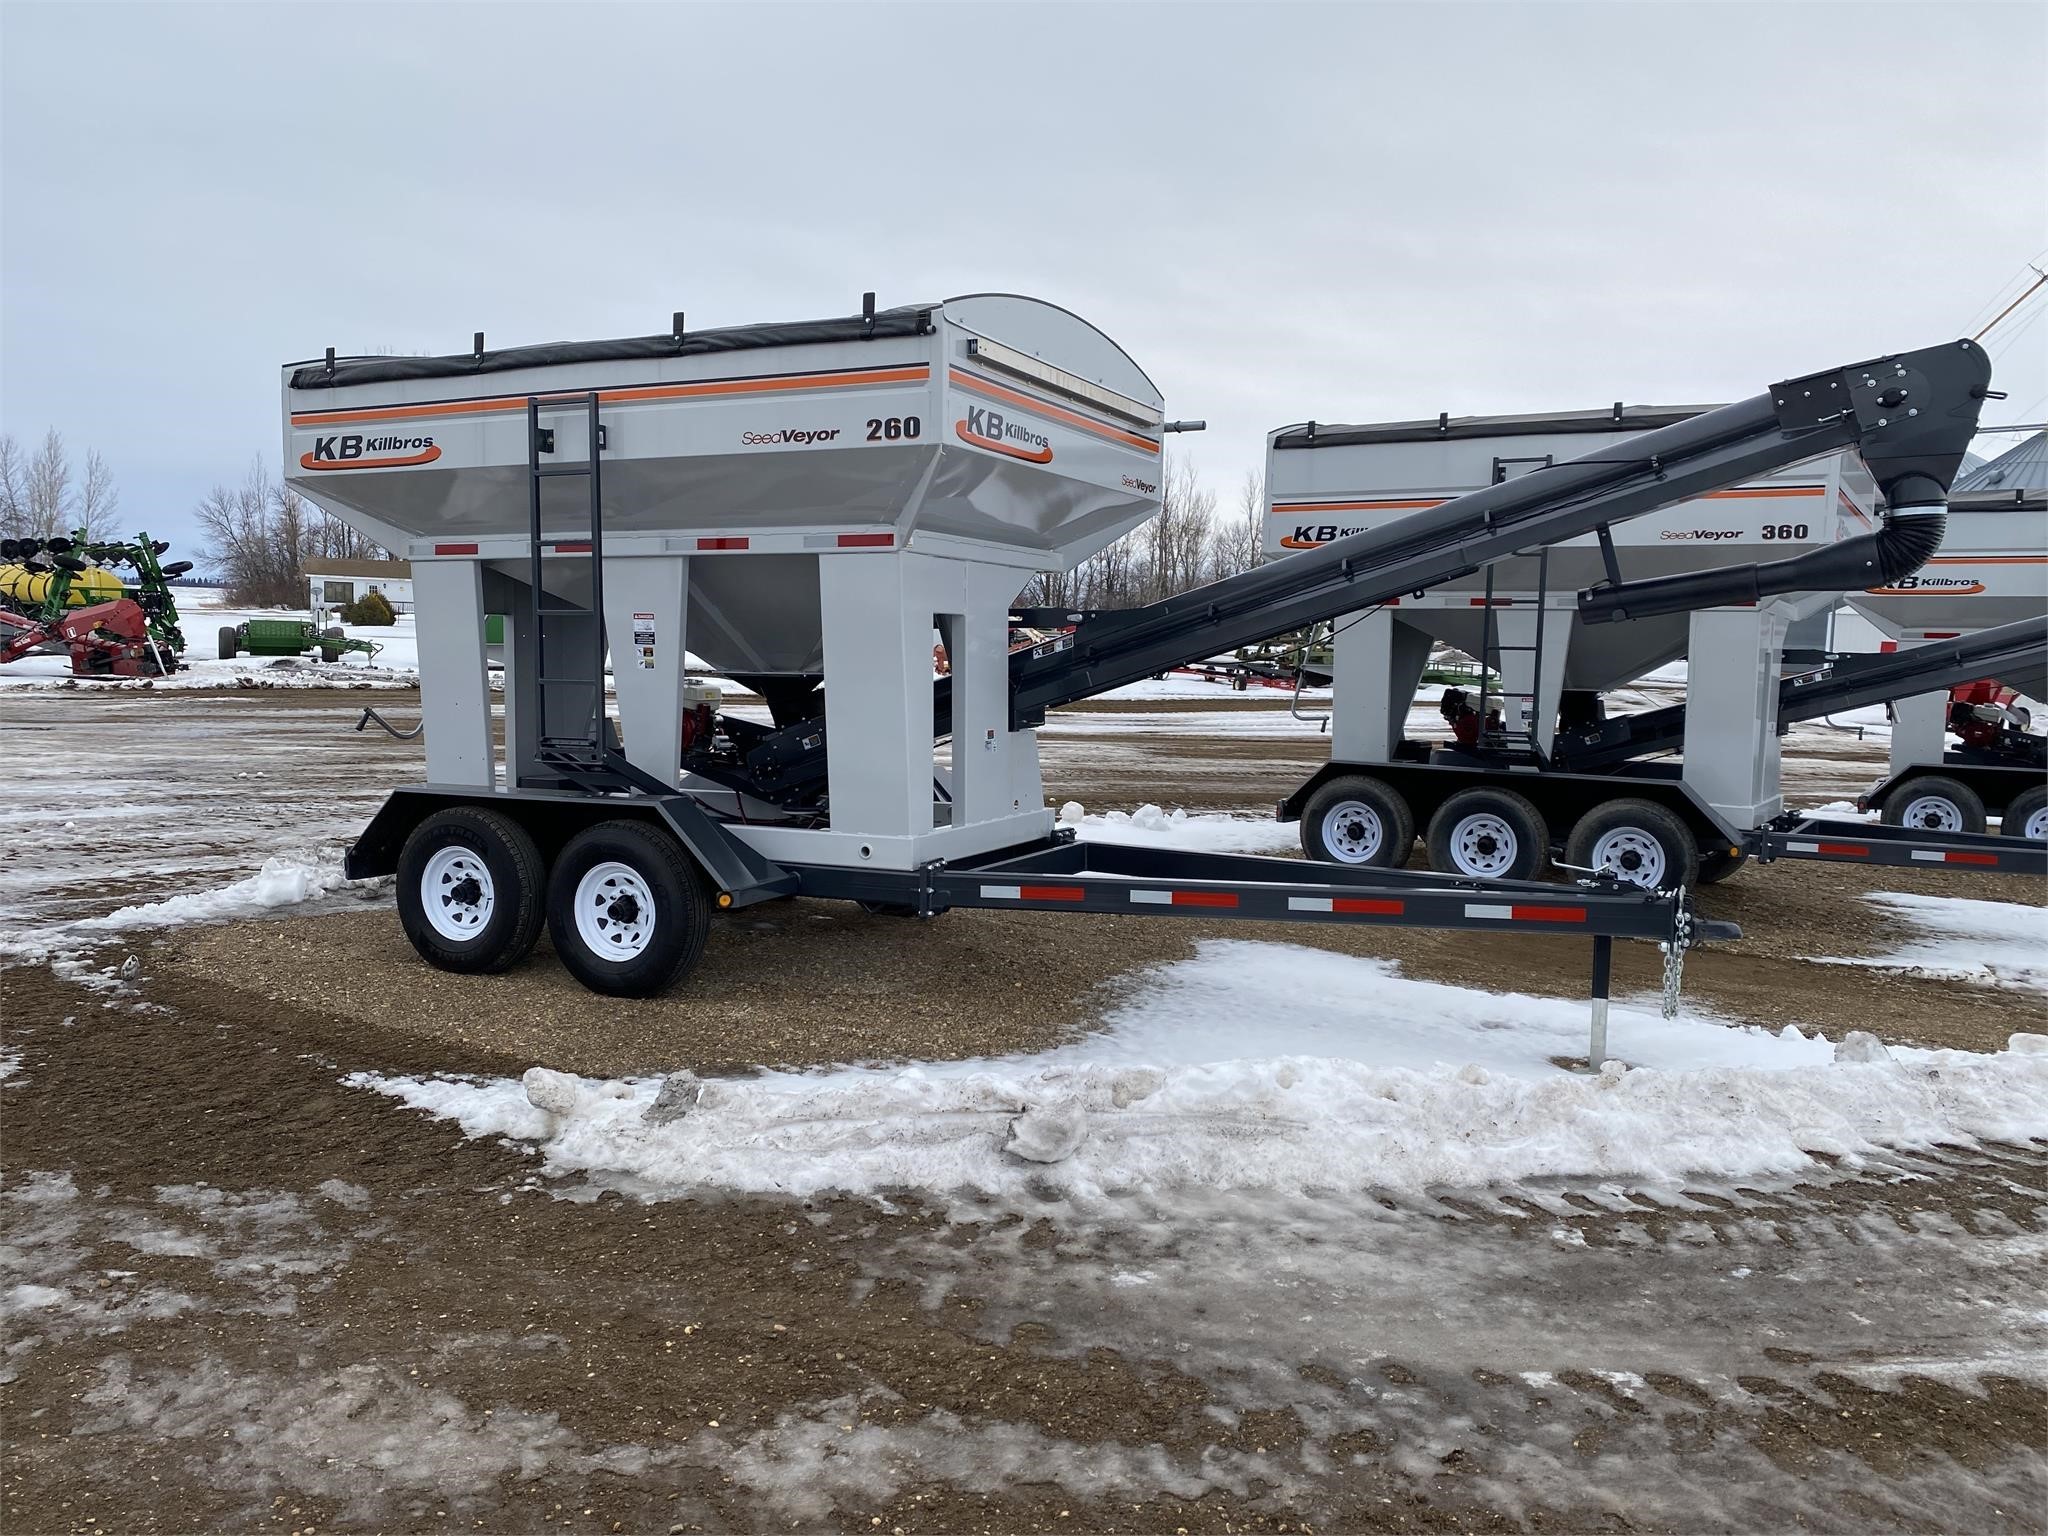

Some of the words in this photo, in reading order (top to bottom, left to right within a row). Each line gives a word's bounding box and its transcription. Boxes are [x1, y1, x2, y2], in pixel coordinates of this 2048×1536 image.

[741, 429, 840, 445] SeedVeyor
[866, 416, 921, 442] 260
[966, 405, 1004, 441] KB
[1005, 422, 1049, 448] Killbros
[313, 434, 363, 461] KB
[365, 436, 434, 452] Killbros
[1121, 474, 1157, 494] SeedVeyor
[1292, 525, 1338, 542] KB
[1660, 530, 1744, 541] SeedVeyor
[1761, 524, 1809, 540] 360
[1920, 578, 1979, 586] Killbros
